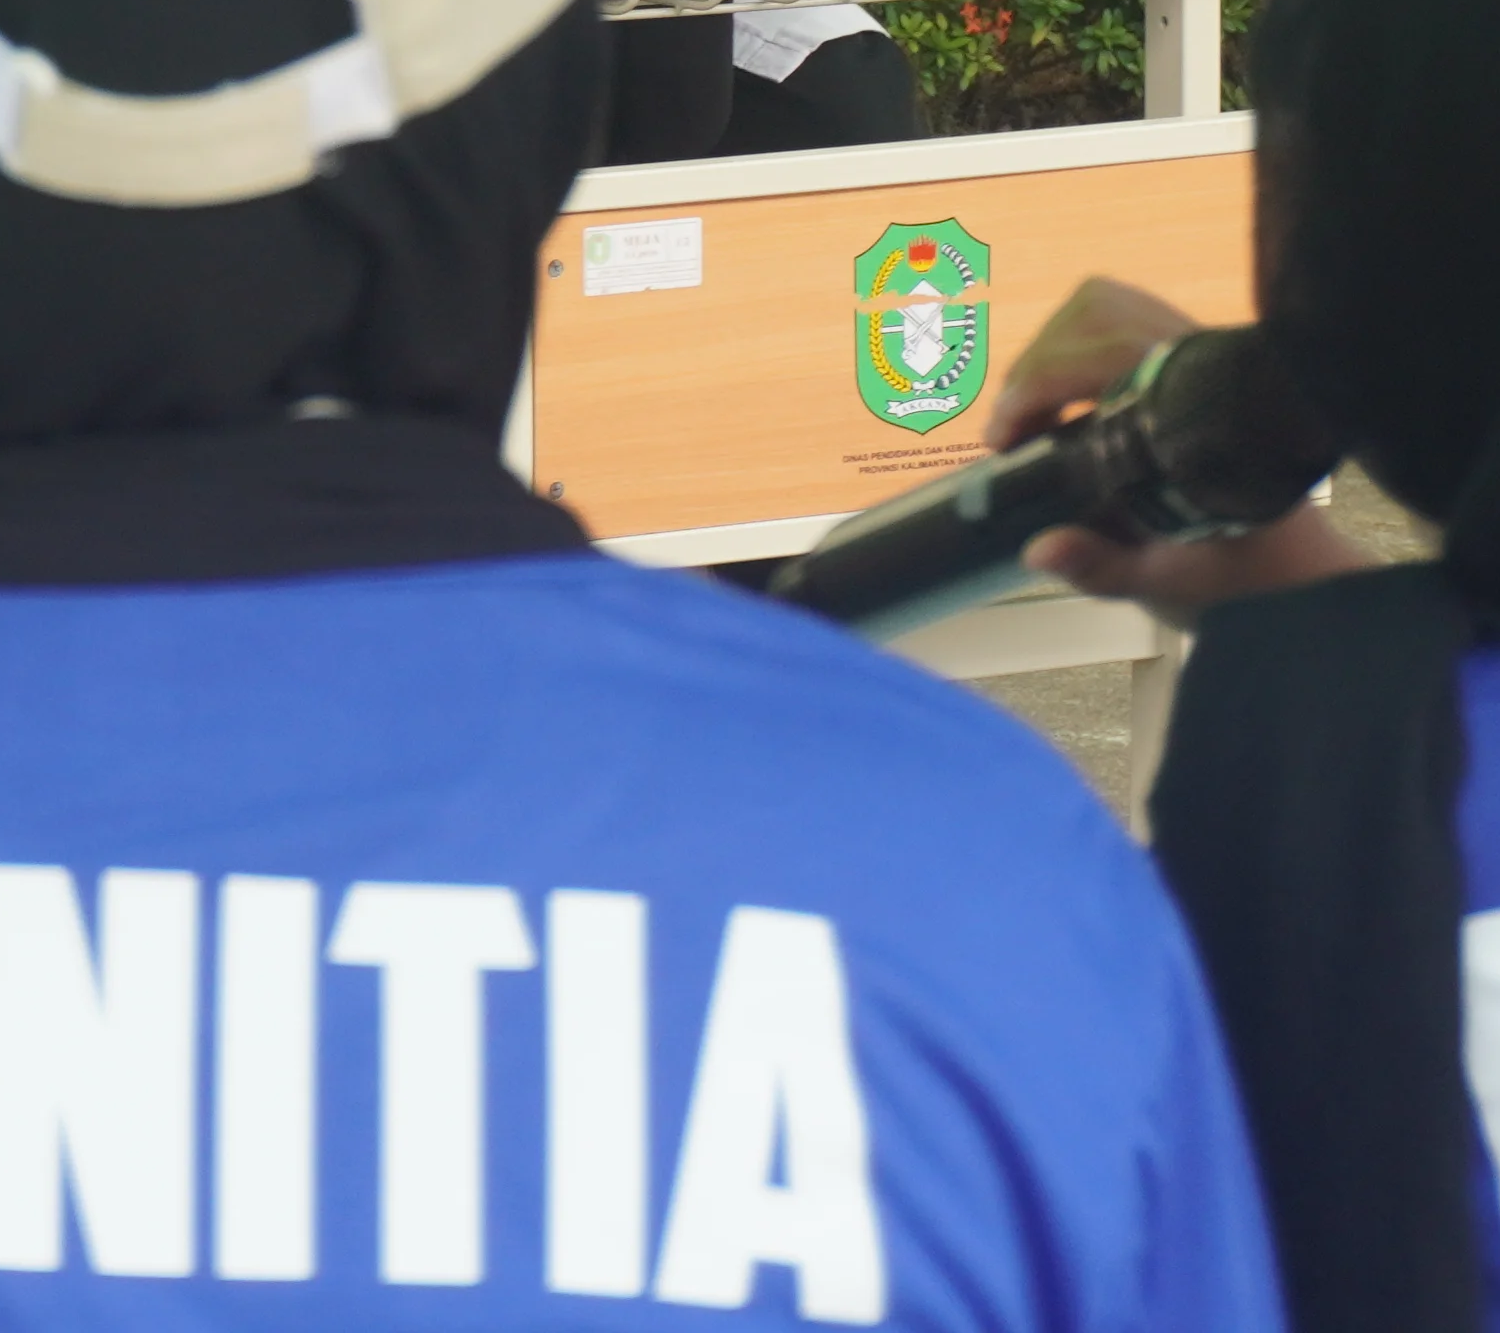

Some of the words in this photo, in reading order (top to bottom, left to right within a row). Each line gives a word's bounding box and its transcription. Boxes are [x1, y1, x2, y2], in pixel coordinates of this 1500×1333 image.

[842, 454, 868, 463] DINAS
[871, 450, 923, 460] PENDIDIKAN
[859, 464, 899, 474] PROVINSI
[901, 459, 955, 470] KALIMANTAN
